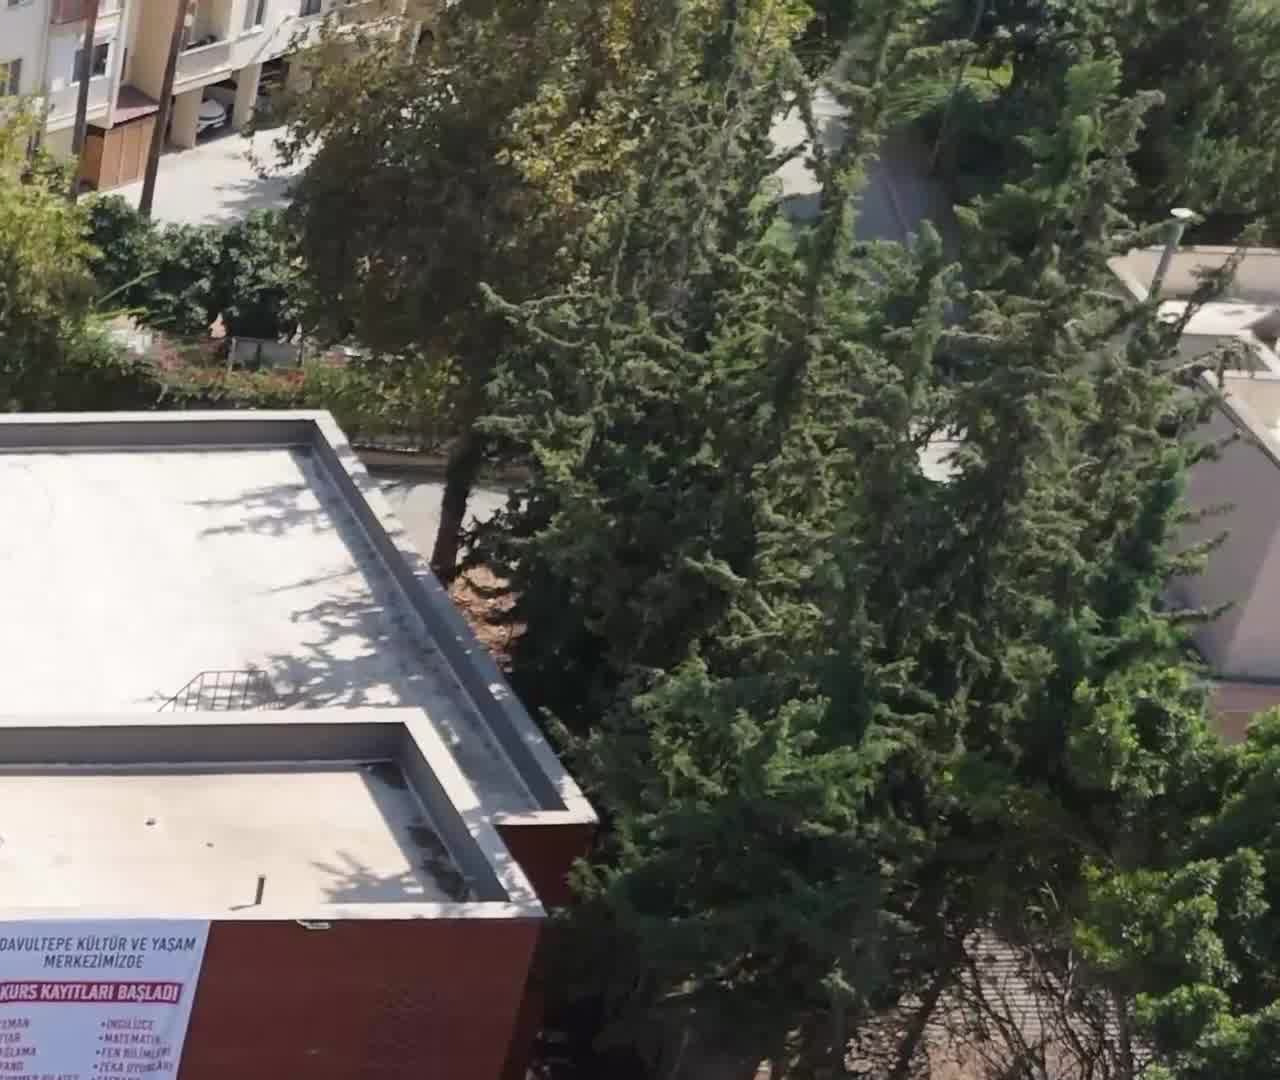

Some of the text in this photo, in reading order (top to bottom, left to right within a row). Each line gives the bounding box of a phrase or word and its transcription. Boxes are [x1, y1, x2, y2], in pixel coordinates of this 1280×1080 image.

[0, 934, 197, 953] DAVULTEPE KÜLTÜR VE YAŞAM
[0, 984, 179, 1003] KURS KAYITLARI BAŞLADI
